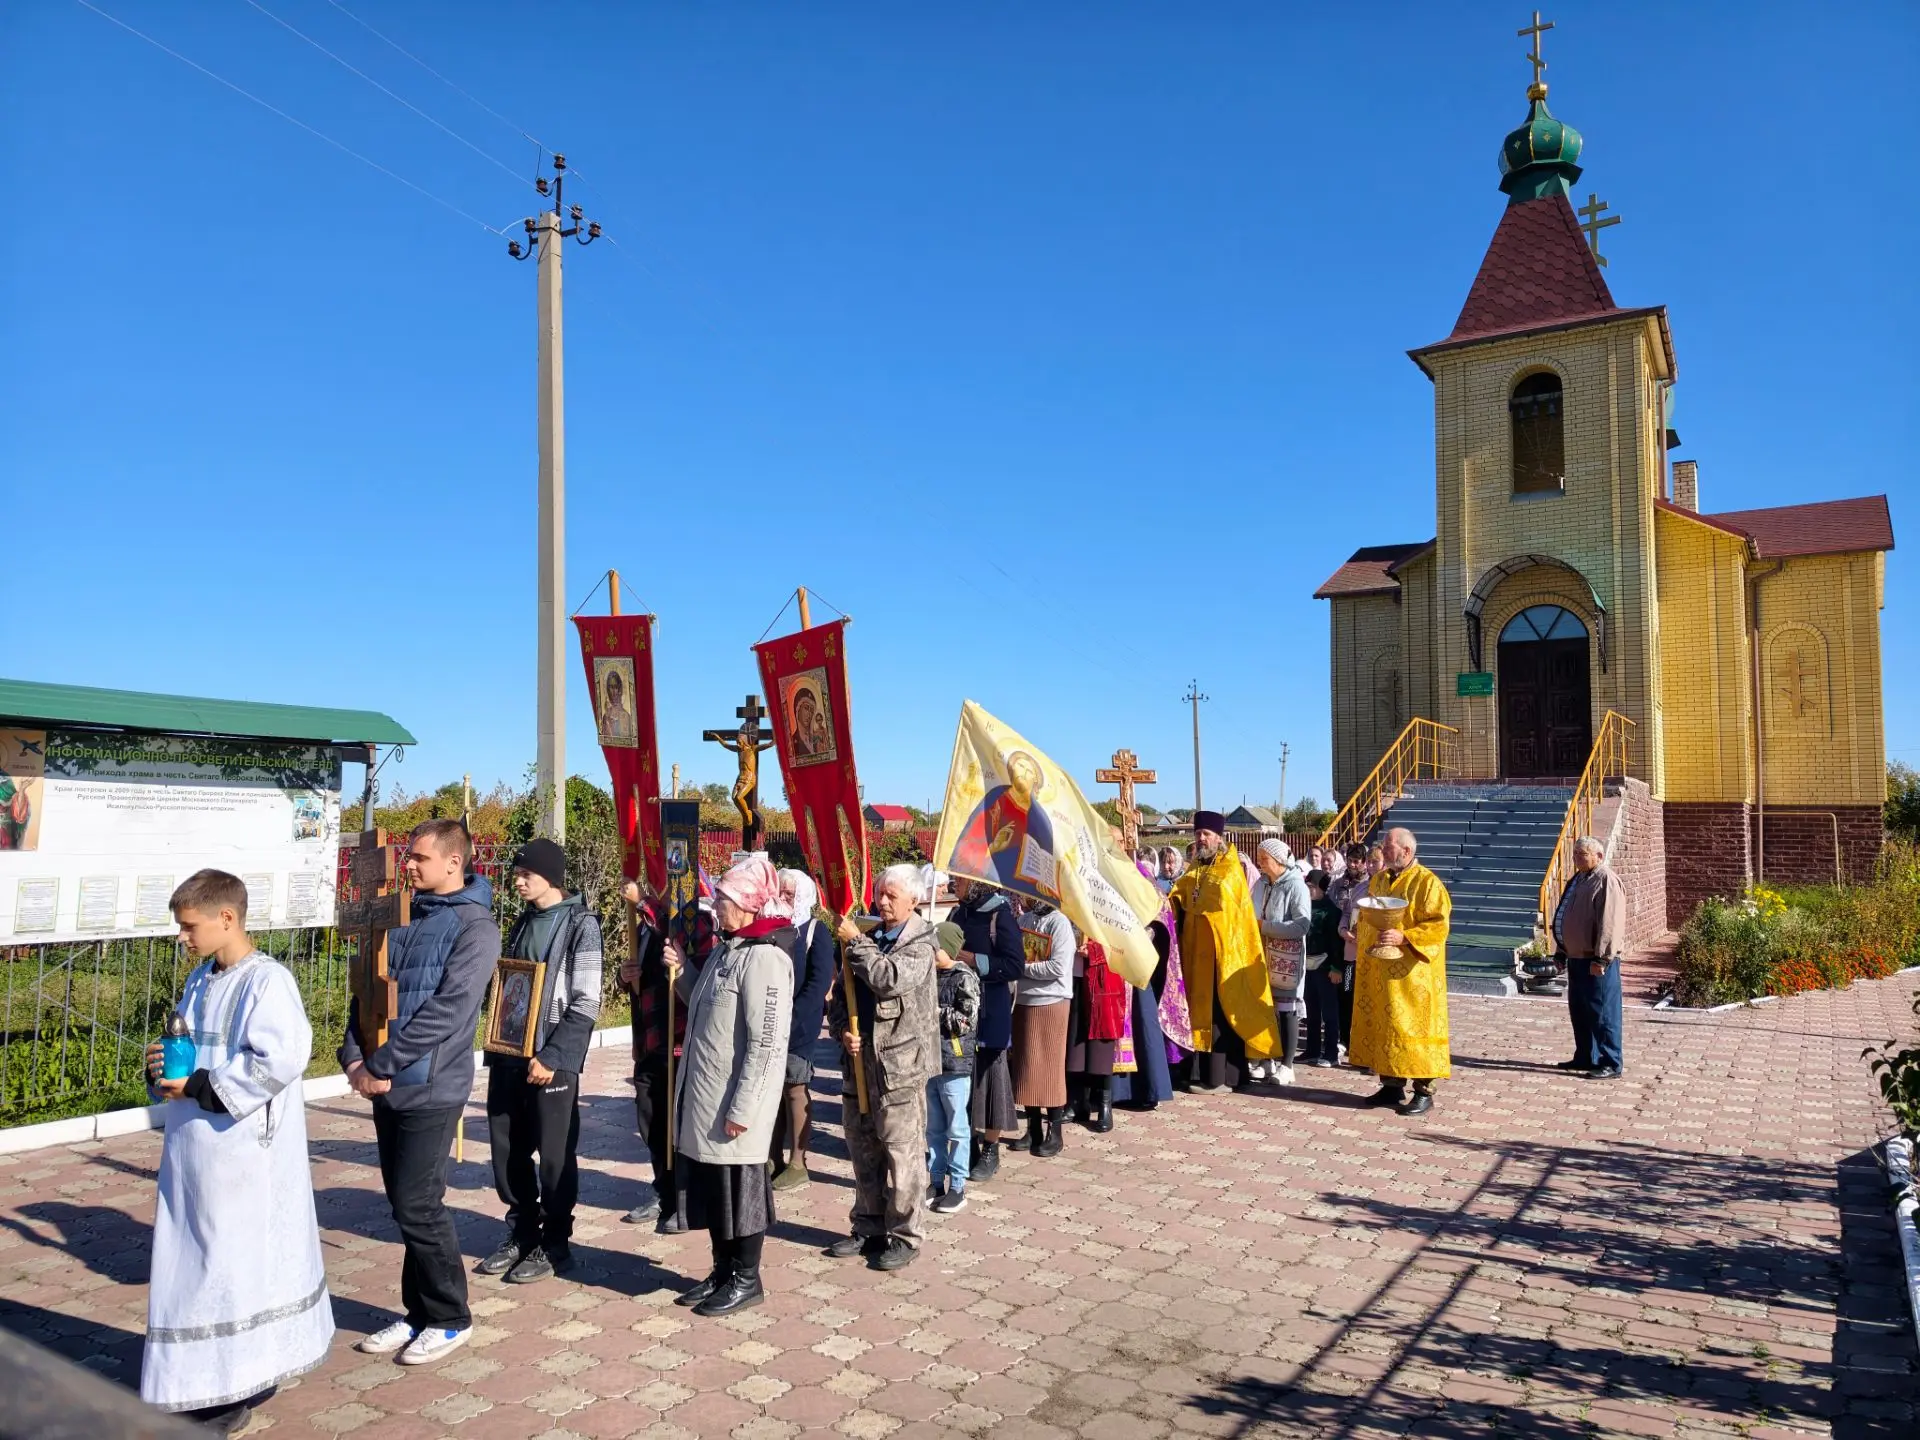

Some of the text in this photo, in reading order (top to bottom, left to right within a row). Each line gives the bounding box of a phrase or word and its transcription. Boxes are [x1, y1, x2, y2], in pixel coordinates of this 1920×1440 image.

[298, 760, 333, 771] СТЕНД
[88, 769, 126, 778] Прихода
[222, 774, 254, 782] Пророка
[54, 786, 72, 794] Храм
[74, 786, 107, 794] построен
[77, 793, 106, 801] Русской
[108, 794, 155, 802] Православной
